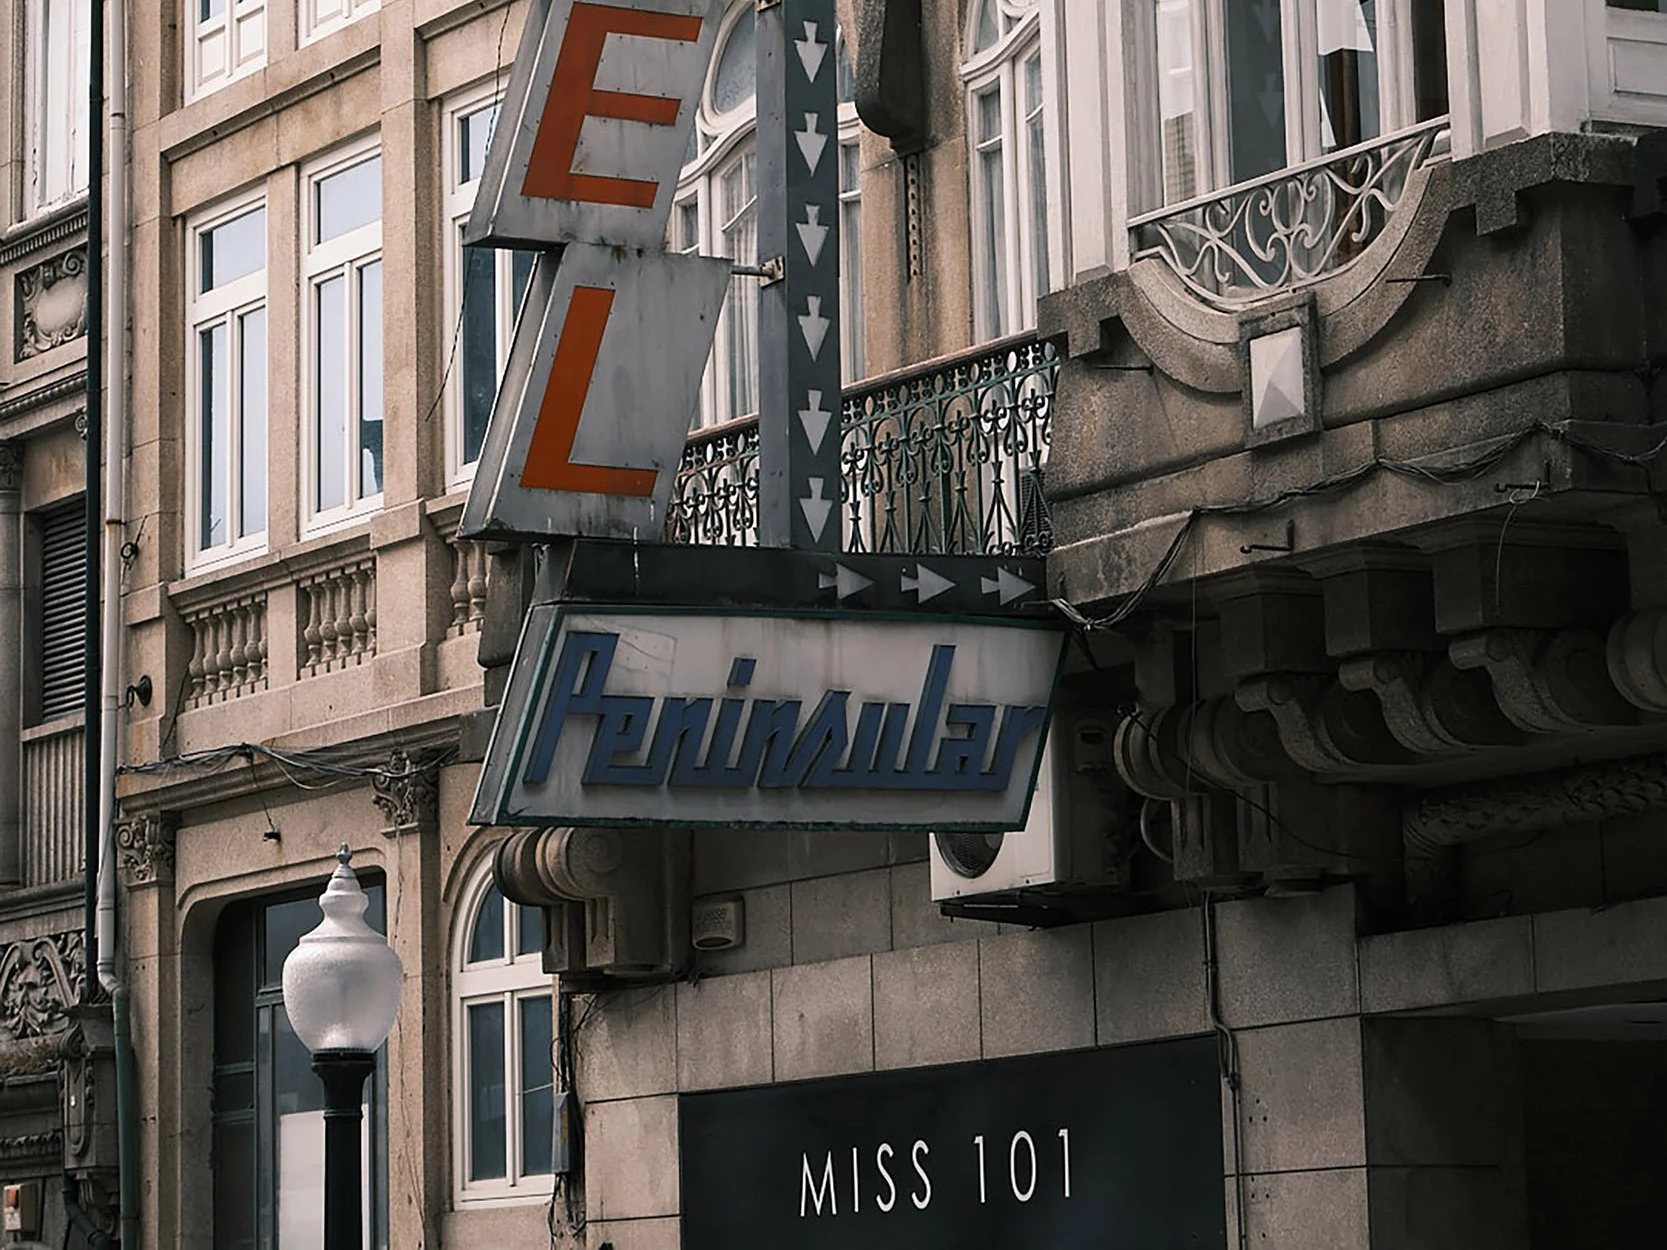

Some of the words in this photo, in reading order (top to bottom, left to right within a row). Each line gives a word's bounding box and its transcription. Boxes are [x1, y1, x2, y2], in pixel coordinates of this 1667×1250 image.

[522, 631, 1047, 792] Peninsular
[799, 1140, 932, 1217] MISS
[974, 1127, 1071, 1203] 101
